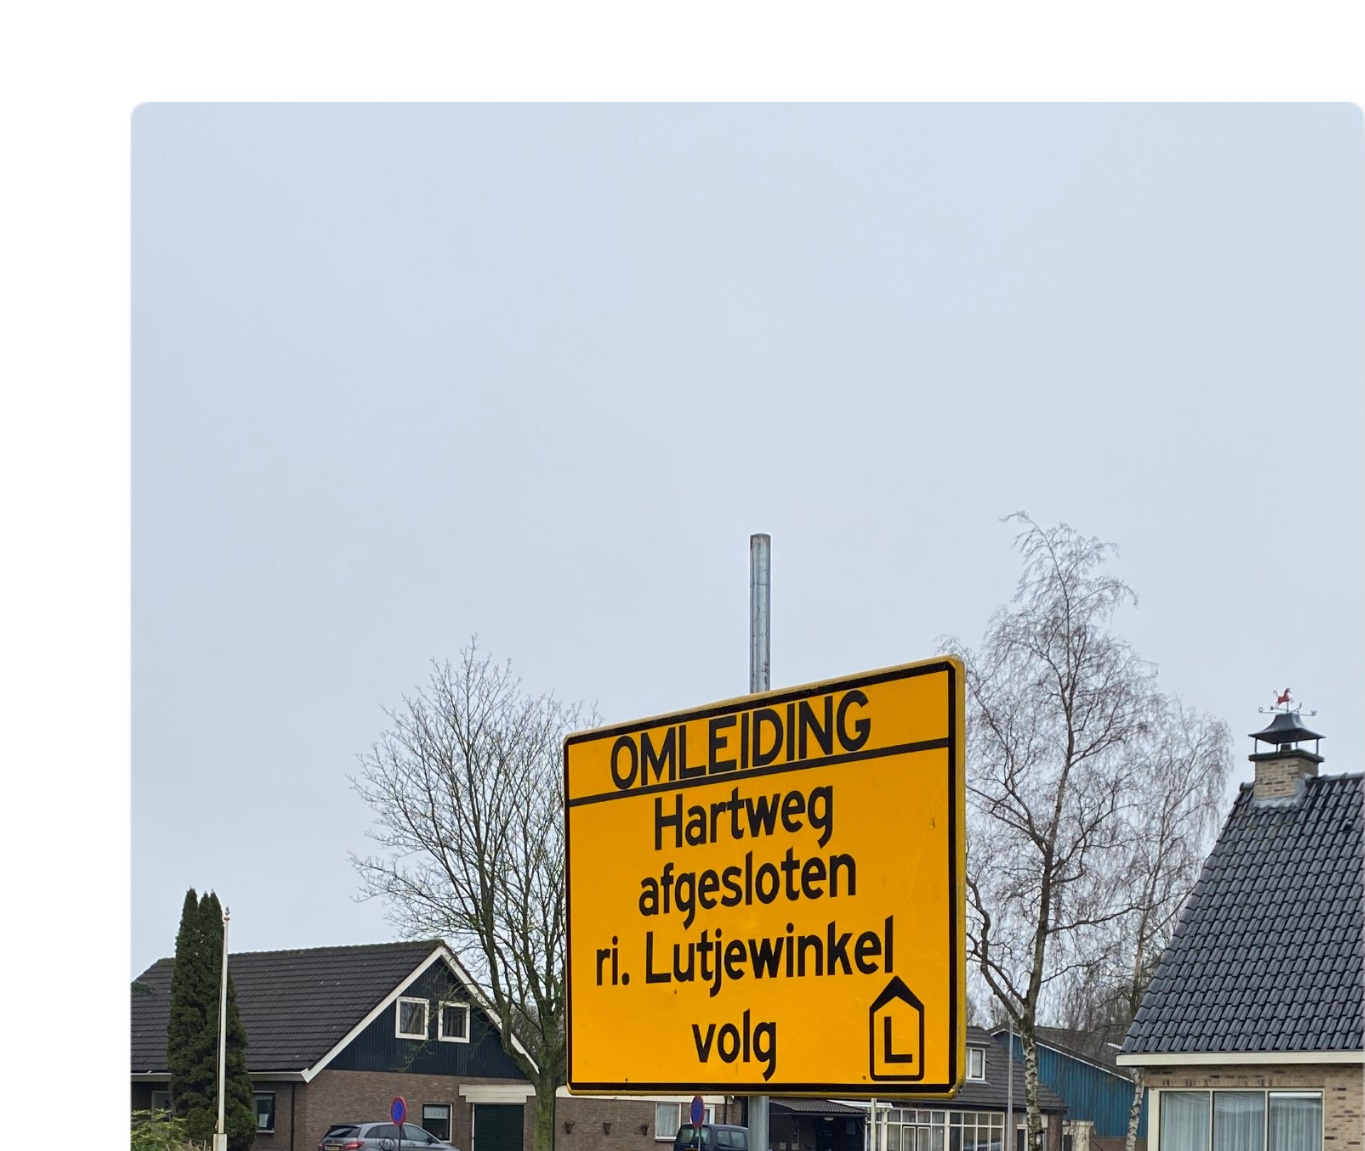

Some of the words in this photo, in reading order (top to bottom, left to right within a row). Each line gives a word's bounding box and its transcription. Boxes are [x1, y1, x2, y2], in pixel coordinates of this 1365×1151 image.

[611, 690, 872, 790] OMLEIDING
[654, 785, 834, 851] Hartweg
[639, 851, 857, 930] afgesloten
[596, 936, 630, 987] ri.
[645, 914, 894, 998] Lutjewinkel
[691, 1008, 777, 1082] volg
[884, 1016, 913, 1064] L
